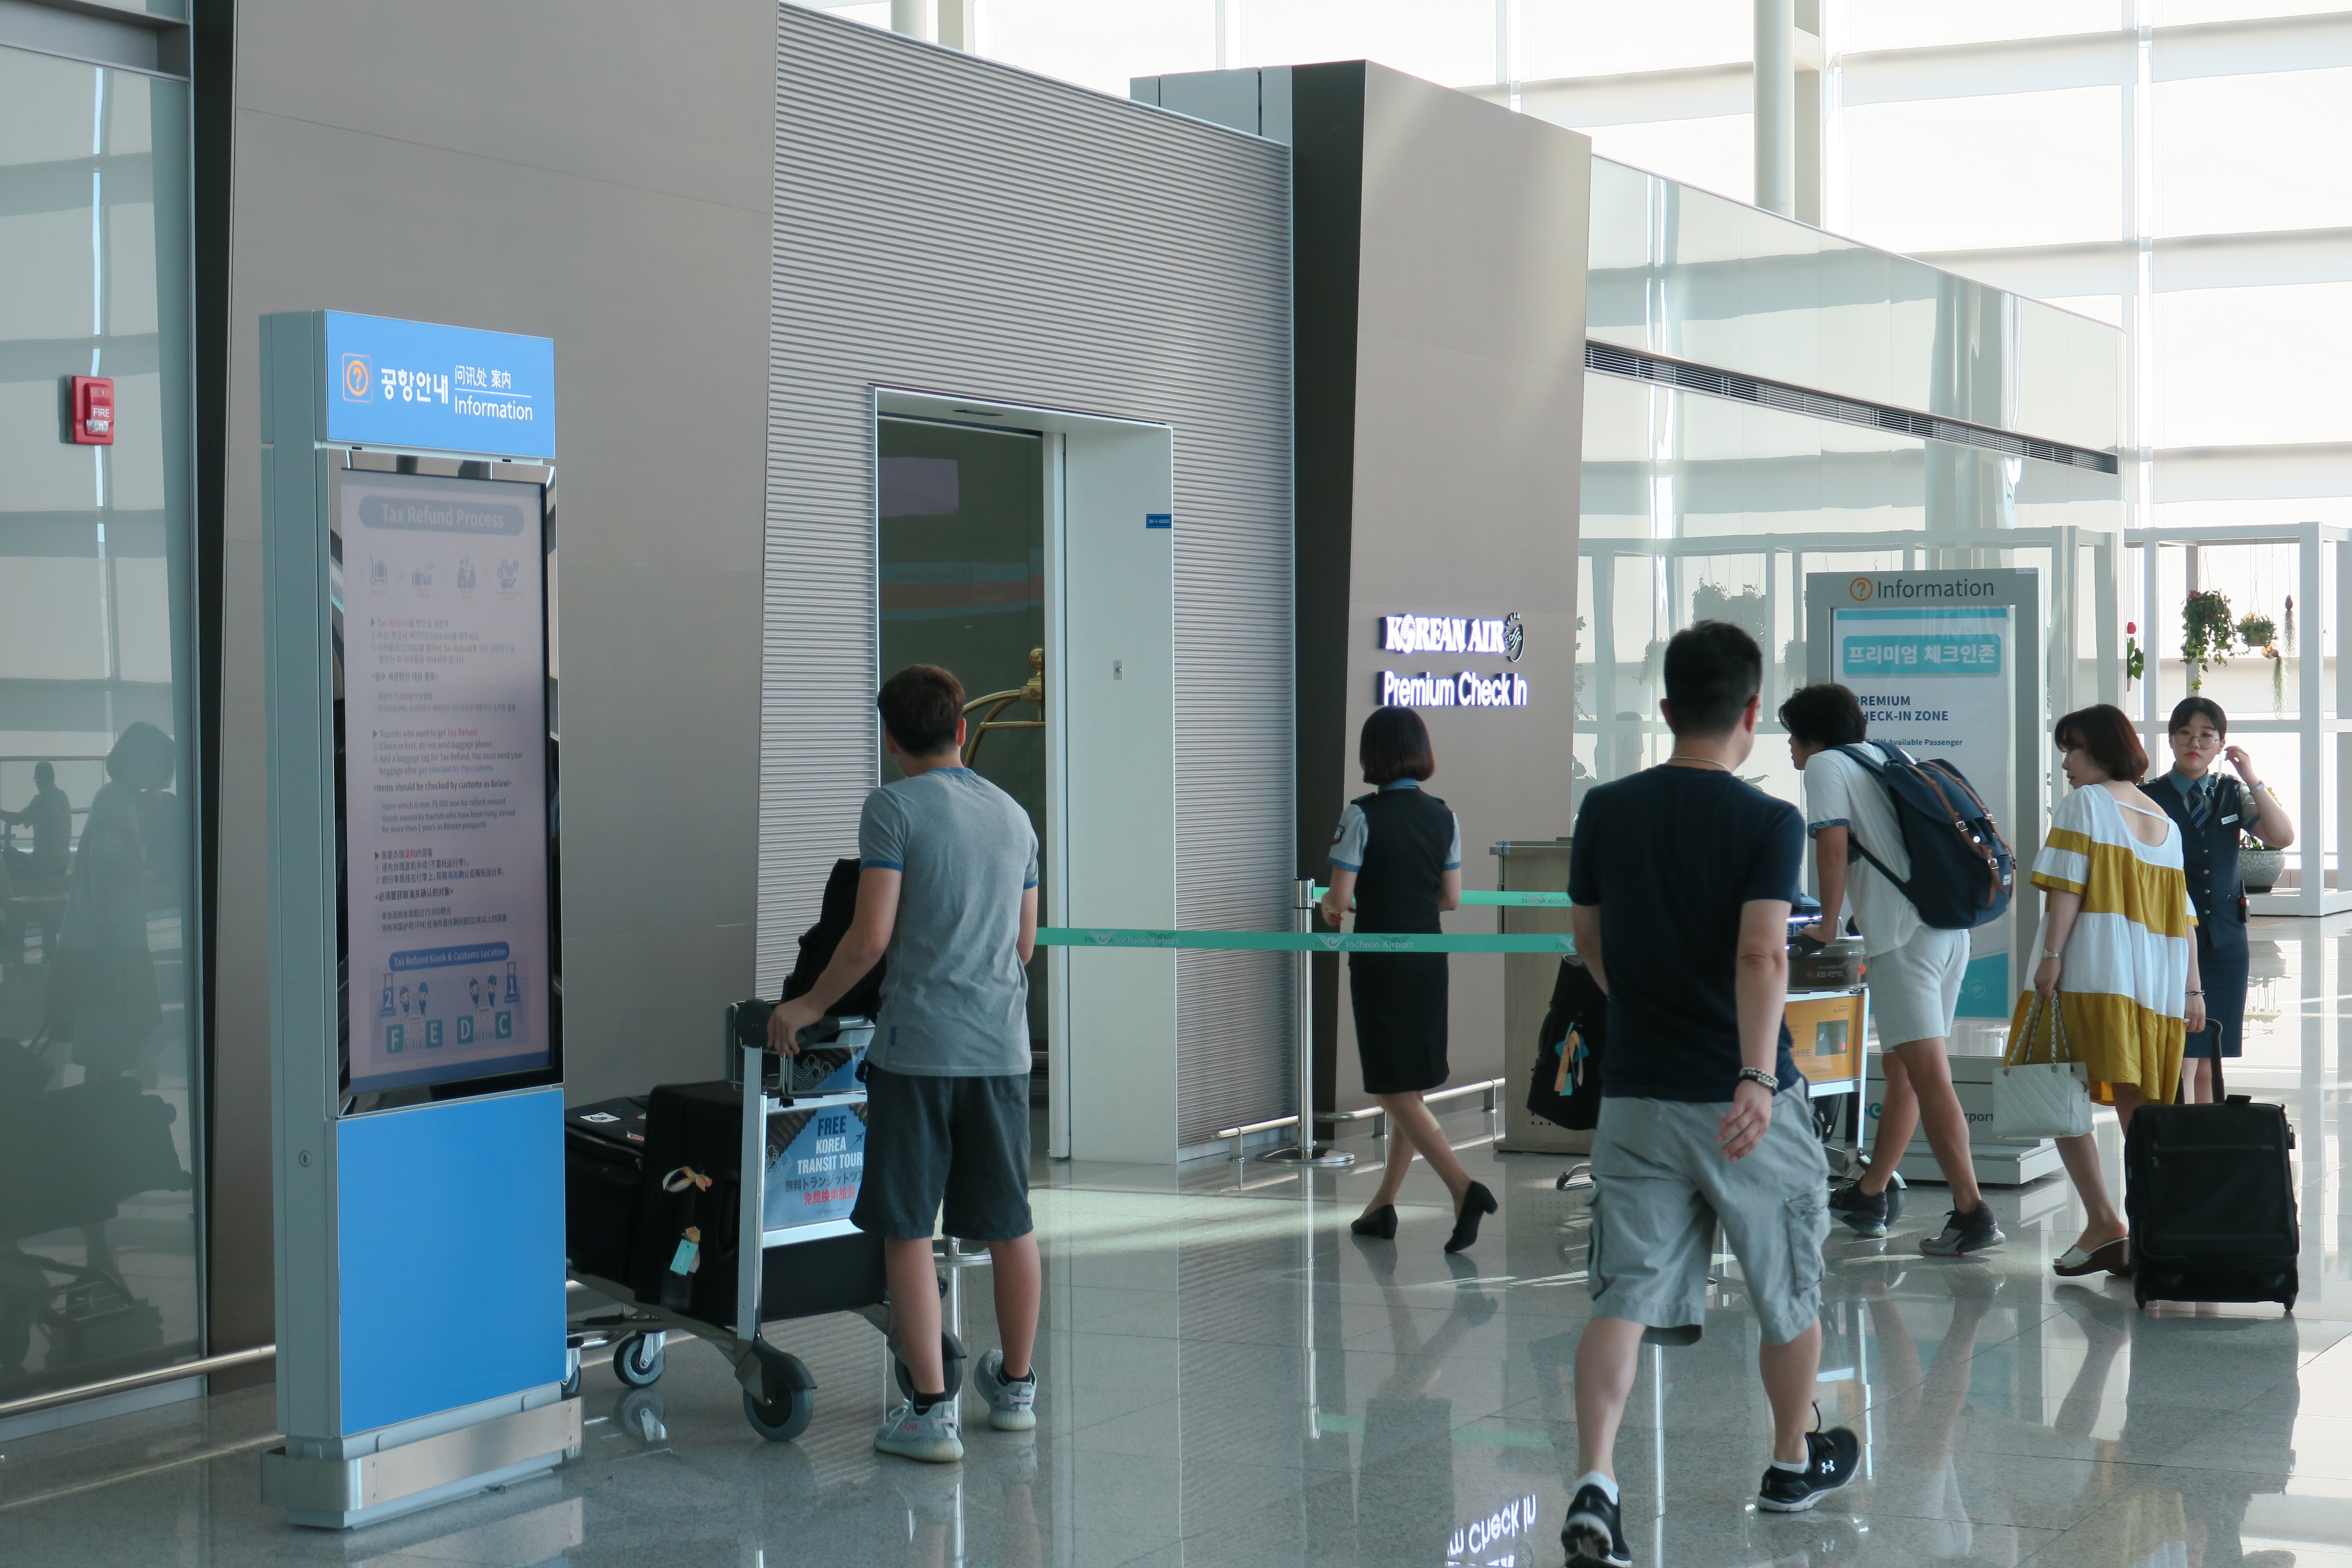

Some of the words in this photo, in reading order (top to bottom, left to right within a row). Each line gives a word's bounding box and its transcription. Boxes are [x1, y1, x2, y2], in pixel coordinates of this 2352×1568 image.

[455, 364, 487, 387] 问讯处
[491, 368, 511, 389] 案内
[381, 368, 448, 404] 공항안내
[93, 408, 110, 417] FIRE
[455, 395, 533, 421] Information
[382, 504, 403, 522] Tax
[407, 505, 452, 525] Refund
[457, 509, 503, 528] Process
[1877, 579, 1994, 598] Information
[1386, 614, 1466, 653] KOREAN
[1467, 619, 1505, 653] AIR
[1848, 645, 1917, 665] 프리미엄
[1924, 644, 1996, 664] 체크인존
[1384, 670, 1455, 706] Premium
[1458, 671, 1510, 706] Check
[1514, 673, 1527, 705] In
[1862, 711, 1911, 720] HECK-IN
[1915, 711, 1948, 721] ZONE
[438, 730, 446, 738] get
[1925, 739, 1963, 747] Passenger
[380, 742, 404, 750] Check-in
[405, 741, 417, 750] first,
[452, 741, 474, 750] baggage
[475, 740, 493, 749] please.
[397, 753, 420, 764] baggage
[421, 754, 430, 763] tag
[450, 752, 471, 761] Refund,
[511, 752, 523, 760] your
[380, 767, 403, 777] baggage
[404, 766, 416, 775] after
[418, 767, 427, 775] get
[429, 764, 451, 773] checked
[453, 765, 459, 774] by
[471, 764, 495, 772] customs.
[374, 784, 393, 792] <Items
[395, 782, 415, 791] should
[416, 782, 423, 790] be
[425, 781, 449, 790] checked
[450, 780, 457, 791] by
[459, 781, 482, 789] customs
[491, 779, 511, 787] below>
[432, 800, 448, 809] 75,000
[382, 814, 398, 822] Goods
[400, 813, 417, 821] owned
[418, 812, 424, 822] by
[426, 812, 444, 820] tourists
[446, 811, 456, 819] who
[484, 809, 497, 819] living
[499, 808, 515, 816] abroad
[423, 824, 436, 833] years
[462, 821, 487, 830] passports
[1383, 941, 1413, 949] Airport
[394, 958, 404, 967] Tax
[406, 955, 428, 965] Refund
[430, 953, 446, 962] Kiosk
[453, 950, 479, 960] Customs
[481, 947, 506, 957] Location
[509, 978, 515, 994] 1
[385, 990, 392, 1008] 2
[391, 1029, 400, 1050] F
[430, 1023, 438, 1044] E
[461, 1020, 470, 1039] D
[499, 1014, 508, 1034] C
[818, 1115, 847, 1136] FREE
[1965, 1113, 1993, 1123] rport
[816, 1136, 846, 1154] KOREA
[797, 1155, 837, 1175] TRANSIT
[839, 1152, 863, 1169] TOUR
[803, 1185, 855, 1205] 免费换乘旅游
